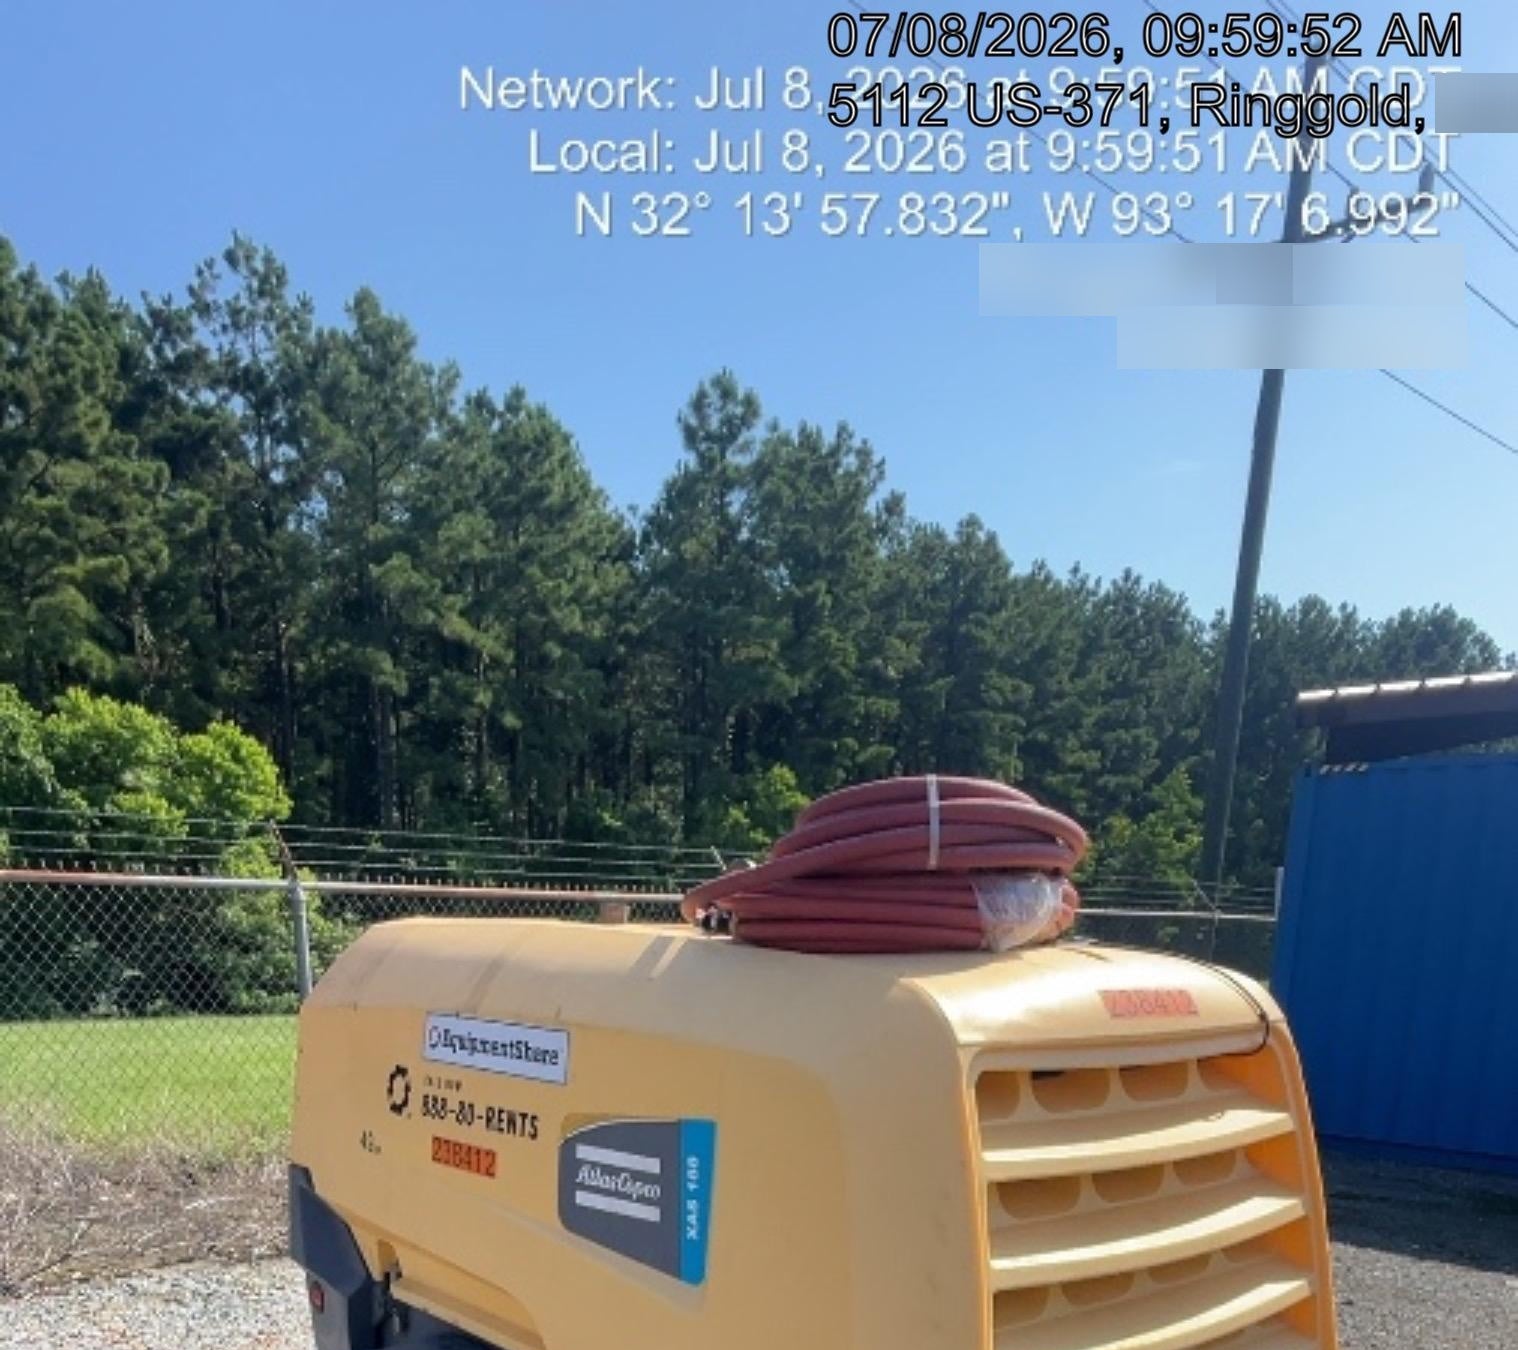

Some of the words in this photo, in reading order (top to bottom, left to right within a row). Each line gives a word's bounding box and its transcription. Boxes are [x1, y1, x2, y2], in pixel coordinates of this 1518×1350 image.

[443, 1027, 559, 1066] EquipmentShare
[421, 1093, 540, 1141] 888-80-RENTS
[685, 1199, 699, 1241] XAS
